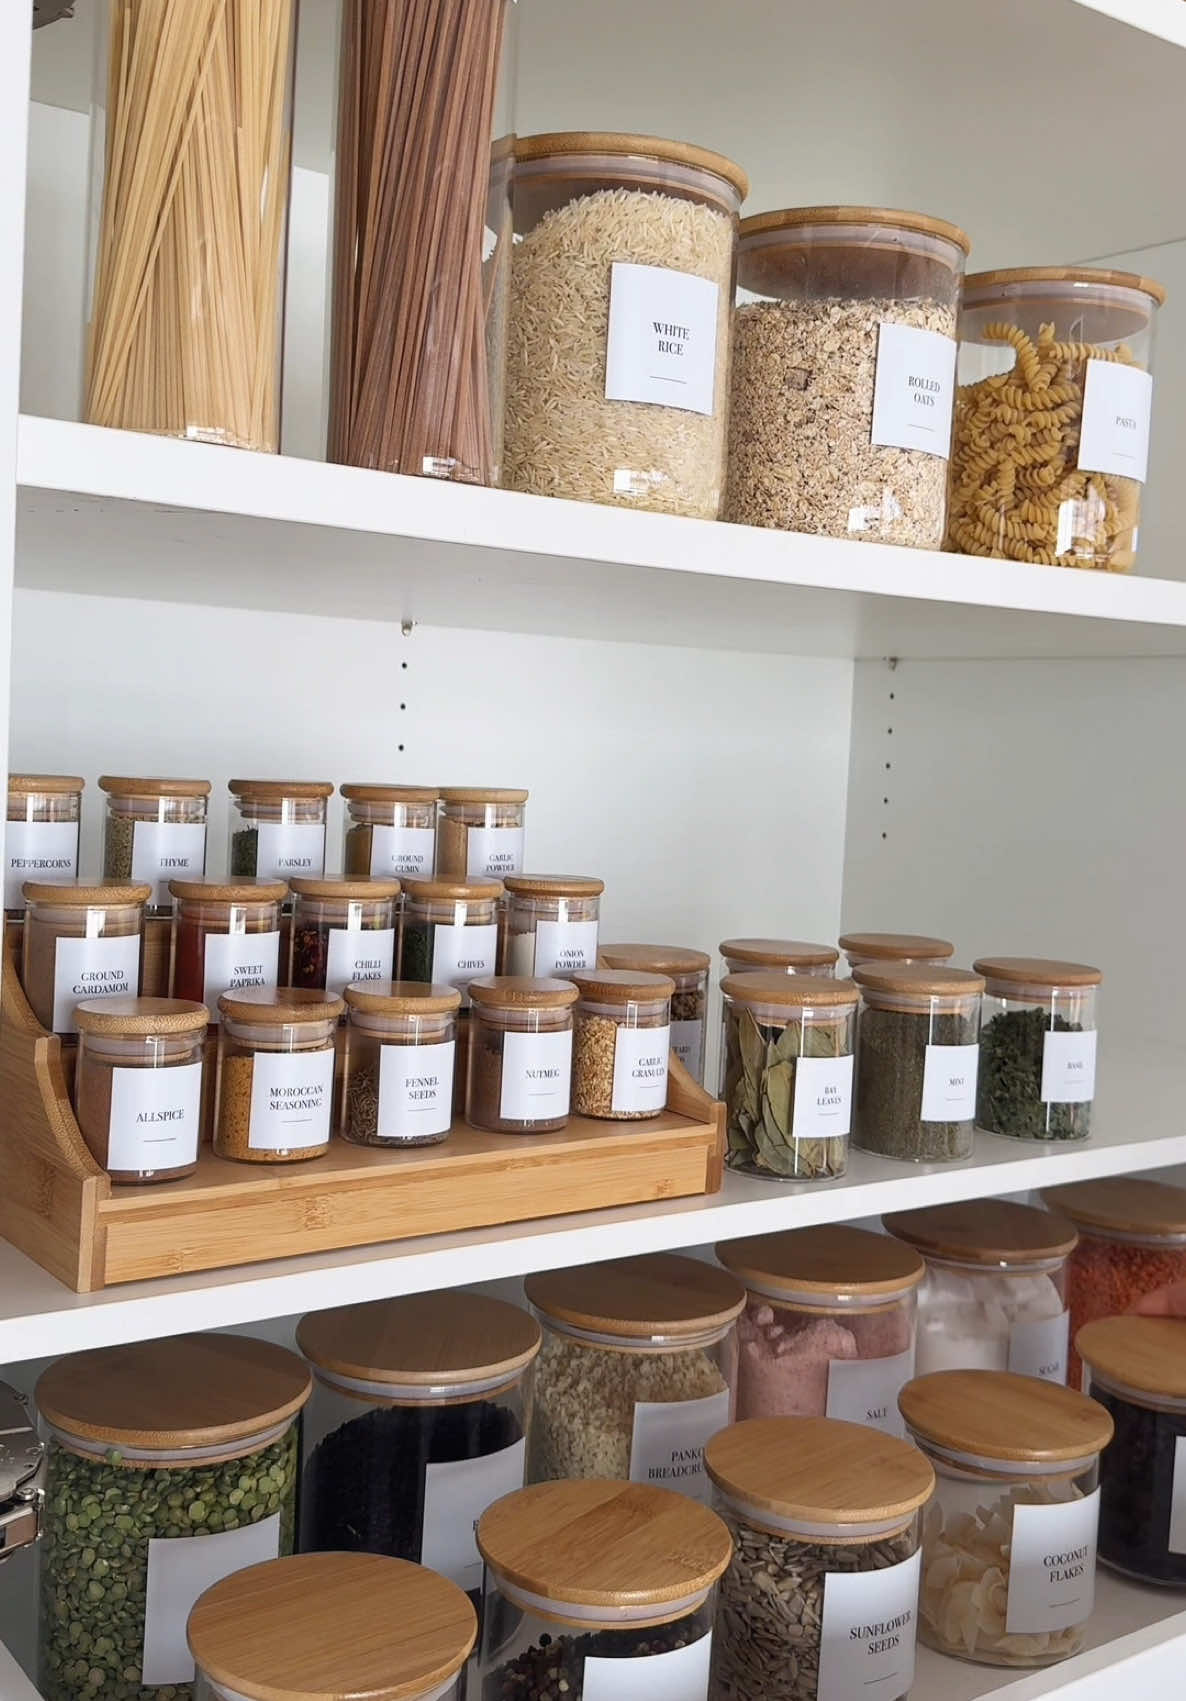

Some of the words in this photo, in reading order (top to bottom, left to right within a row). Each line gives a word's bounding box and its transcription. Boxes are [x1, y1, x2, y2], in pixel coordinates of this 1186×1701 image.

[652, 320, 690, 341] WHITE
[657, 339, 685, 356] RICE
[908, 374, 941, 393] ROLLED
[913, 392, 937, 407] OATS
[1115, 415, 1137, 430] PASTA
[10, 858, 72, 869] PEPPERCORNS
[160, 857, 190, 868] THYME
[278, 857, 313, 868] PARSLEY
[391, 854, 424, 864] GROUND
[489, 853, 514, 862] GARLIC
[394, 864, 420, 873] CUMIN
[485, 863, 515, 873] POWDER
[558, 949, 585, 959] ONION
[233, 965, 264, 976] SWEET
[354, 959, 382, 970] CHILLI
[457, 960, 486, 970] CHIVES
[554, 960, 587, 970] POWDER
[80, 970, 125, 982] GROUND
[351, 970, 382, 982] FLAKES
[229, 977, 266, 988] PAPRIKA
[638, 1056, 662, 1067] GARLIC
[525, 1068, 560, 1080] NUTMEG
[405, 1076, 440, 1089] FENNEL
[269, 1085, 324, 1099] MOROCCAN
[407, 1089, 437, 1101] SEEDS
[268, 1098, 322, 1112] SEASONING
[136, 1108, 185, 1124] ALLSPICE
[866, 1406, 888, 1420] SALT
[1043, 1545, 1089, 1567] COCONUT
[1049, 1564, 1085, 1583] FLAKES
[848, 1610, 912, 1640] SUNFLOWER
[867, 1634, 901, 1655] SEEDS
